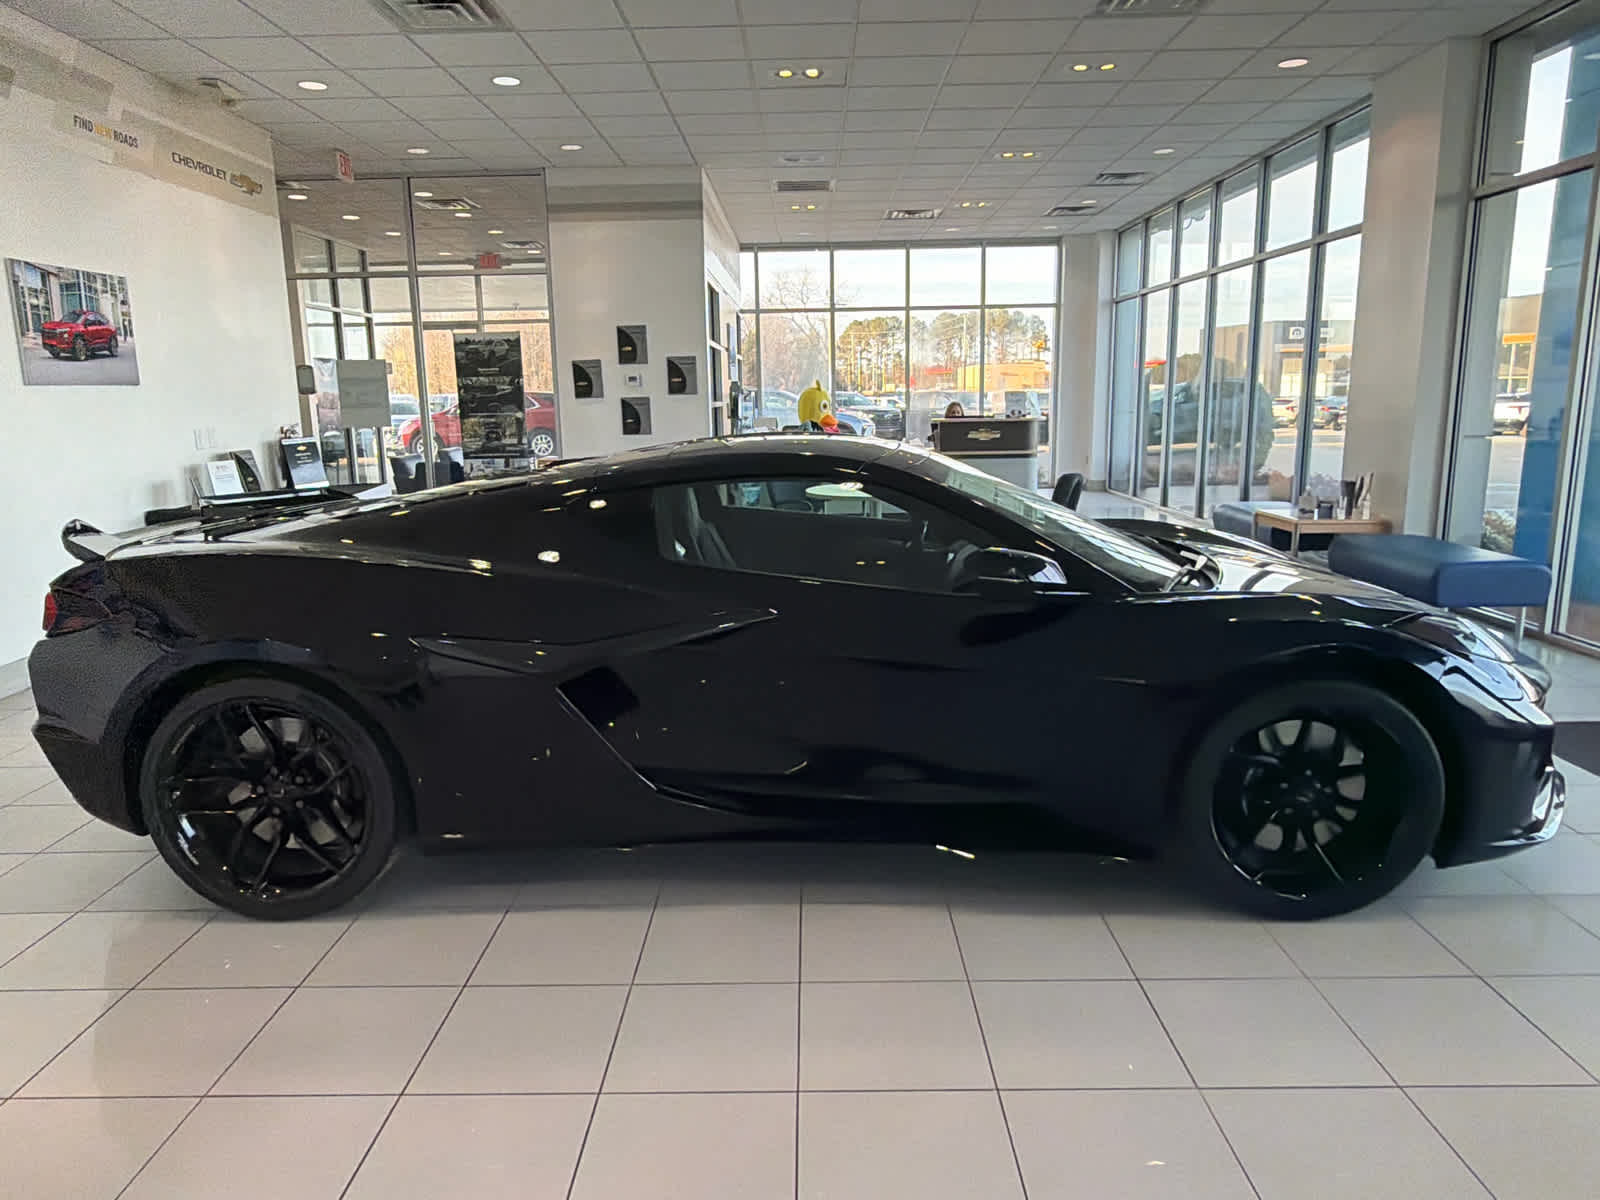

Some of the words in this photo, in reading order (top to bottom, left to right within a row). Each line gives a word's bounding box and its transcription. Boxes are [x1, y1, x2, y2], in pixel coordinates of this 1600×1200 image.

[74, 115, 94, 133] FIND
[94, 122, 113, 139] NEW
[113, 129, 138, 148] ROADS
[172, 152, 227, 181] CHEVROLET
